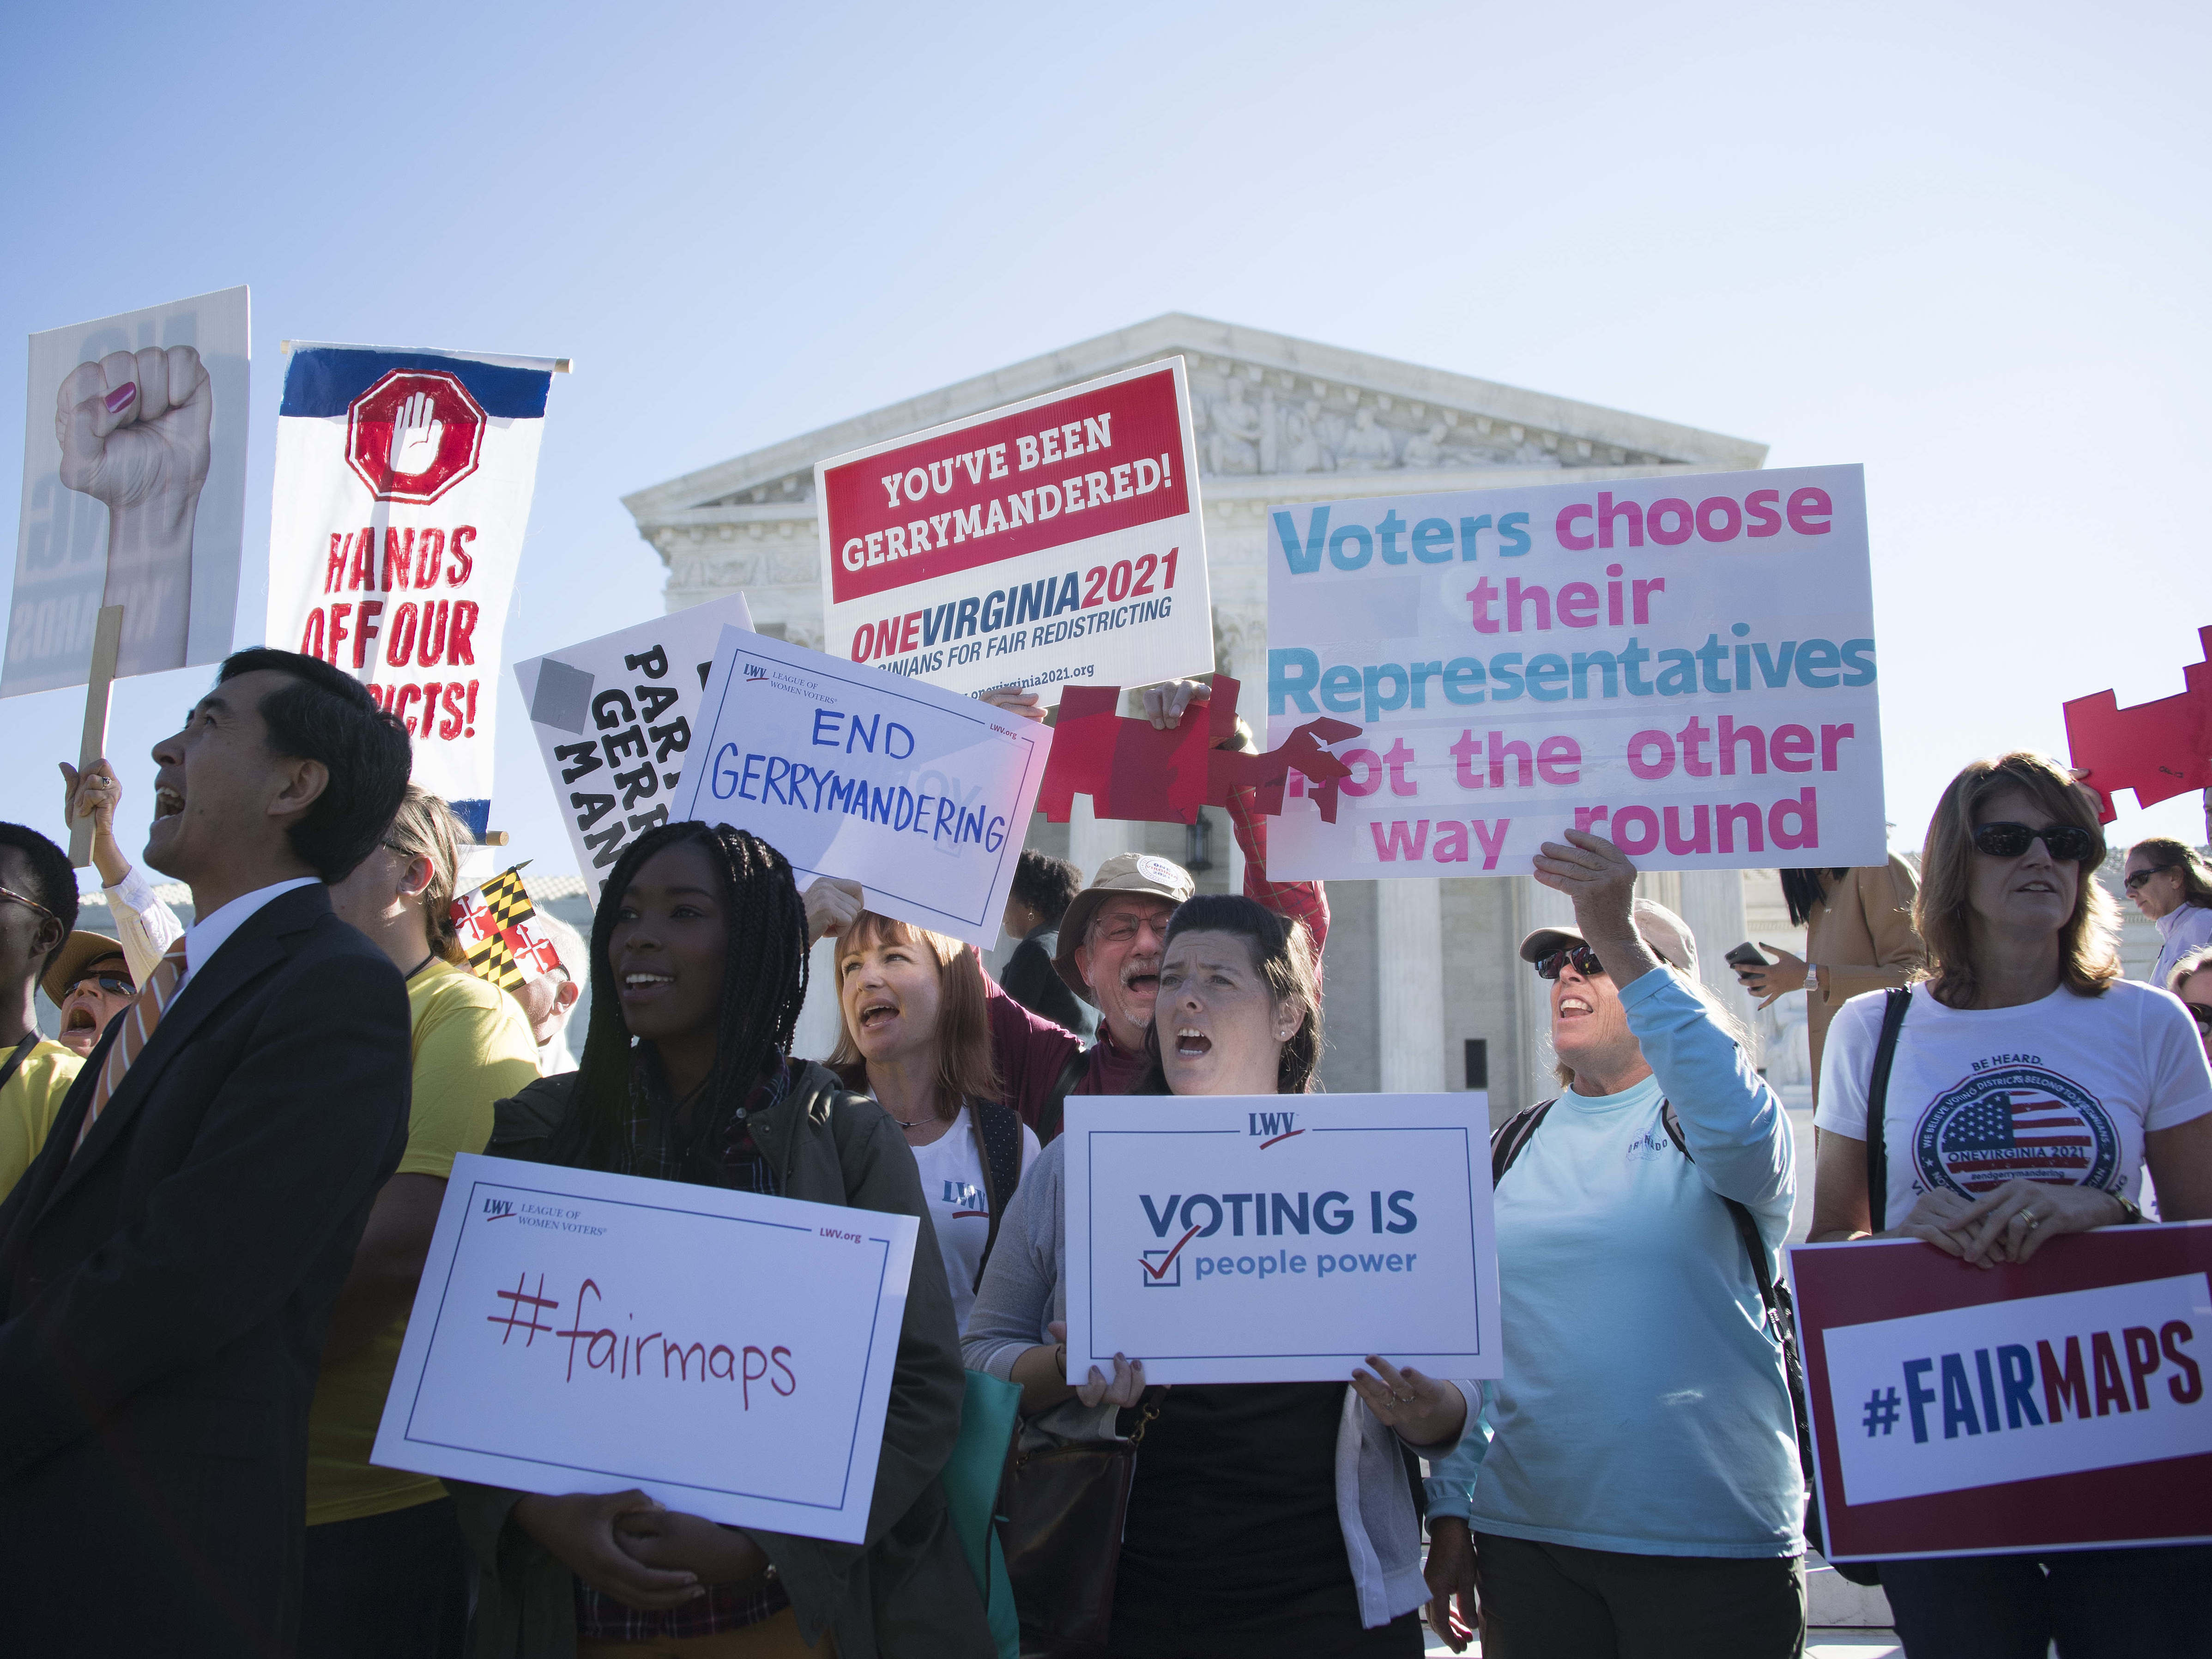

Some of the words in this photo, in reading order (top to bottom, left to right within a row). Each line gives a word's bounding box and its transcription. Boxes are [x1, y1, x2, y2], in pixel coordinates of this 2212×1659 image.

[882, 442, 1009, 508] YOU'VE
[1016, 412, 1112, 471] BEEN
[842, 453, 1172, 572] GERRYMANDERED!
[1273, 505, 1530, 575] Voters
[1555, 487, 1832, 551] choose
[324, 525, 477, 595] HANDS
[1466, 563, 1665, 634] their
[300, 600, 383, 669] OFF
[387, 599, 479, 667] OUR
[947, 641, 981, 668] FOR
[986, 631, 1027, 659] FAIR
[1032, 596, 1172, 648] REDISTRICTING
[743, 663, 767, 678] LWV
[773, 672, 805, 686] LEAGUE
[807, 681, 818, 690] OF
[770, 680, 802, 695] WOMEN
[1268, 622, 1876, 722] Representatives
[624, 644, 691, 789] PAR
[812, 708, 915, 760] END
[990, 723, 1017, 740] LWV.org
[1450, 729, 1582, 790] the
[1626, 715, 1855, 780] other
[554, 740, 632, 896] MAN
[712, 742, 1005, 854] GERRYMANDERING
[1370, 817, 1511, 870] way
[1971, 1059, 1989, 1072] BE
[1992, 1054, 2043, 1066] HEARD.
[1248, 1112, 1295, 1136] LWV
[1922, 1134, 1933, 1149] WE
[1945, 1086, 1978, 1106] VOTING
[2063, 1088, 2077, 1100] TO
[1948, 1147, 2047, 1163] ONEVIRGINIA
[2051, 1145, 2084, 1158] 2021
[483, 1198, 514, 1215] LWV
[520, 1204, 563, 1217] LEAGUE
[566, 1210, 581, 1220] OF
[518, 1216, 559, 1230] WOMEN
[942, 1180, 986, 1212] LWV
[1139, 1191, 1354, 1238] VOTING
[1371, 1190, 1418, 1235] IS
[820, 1228, 862, 1244] LWV.org
[1195, 1249, 1307, 1280] people
[1317, 1251, 1417, 1278] power
[486, 1271, 797, 1411] #fairmaps
[1861, 1319, 2204, 1444] #FAIRMAPS
